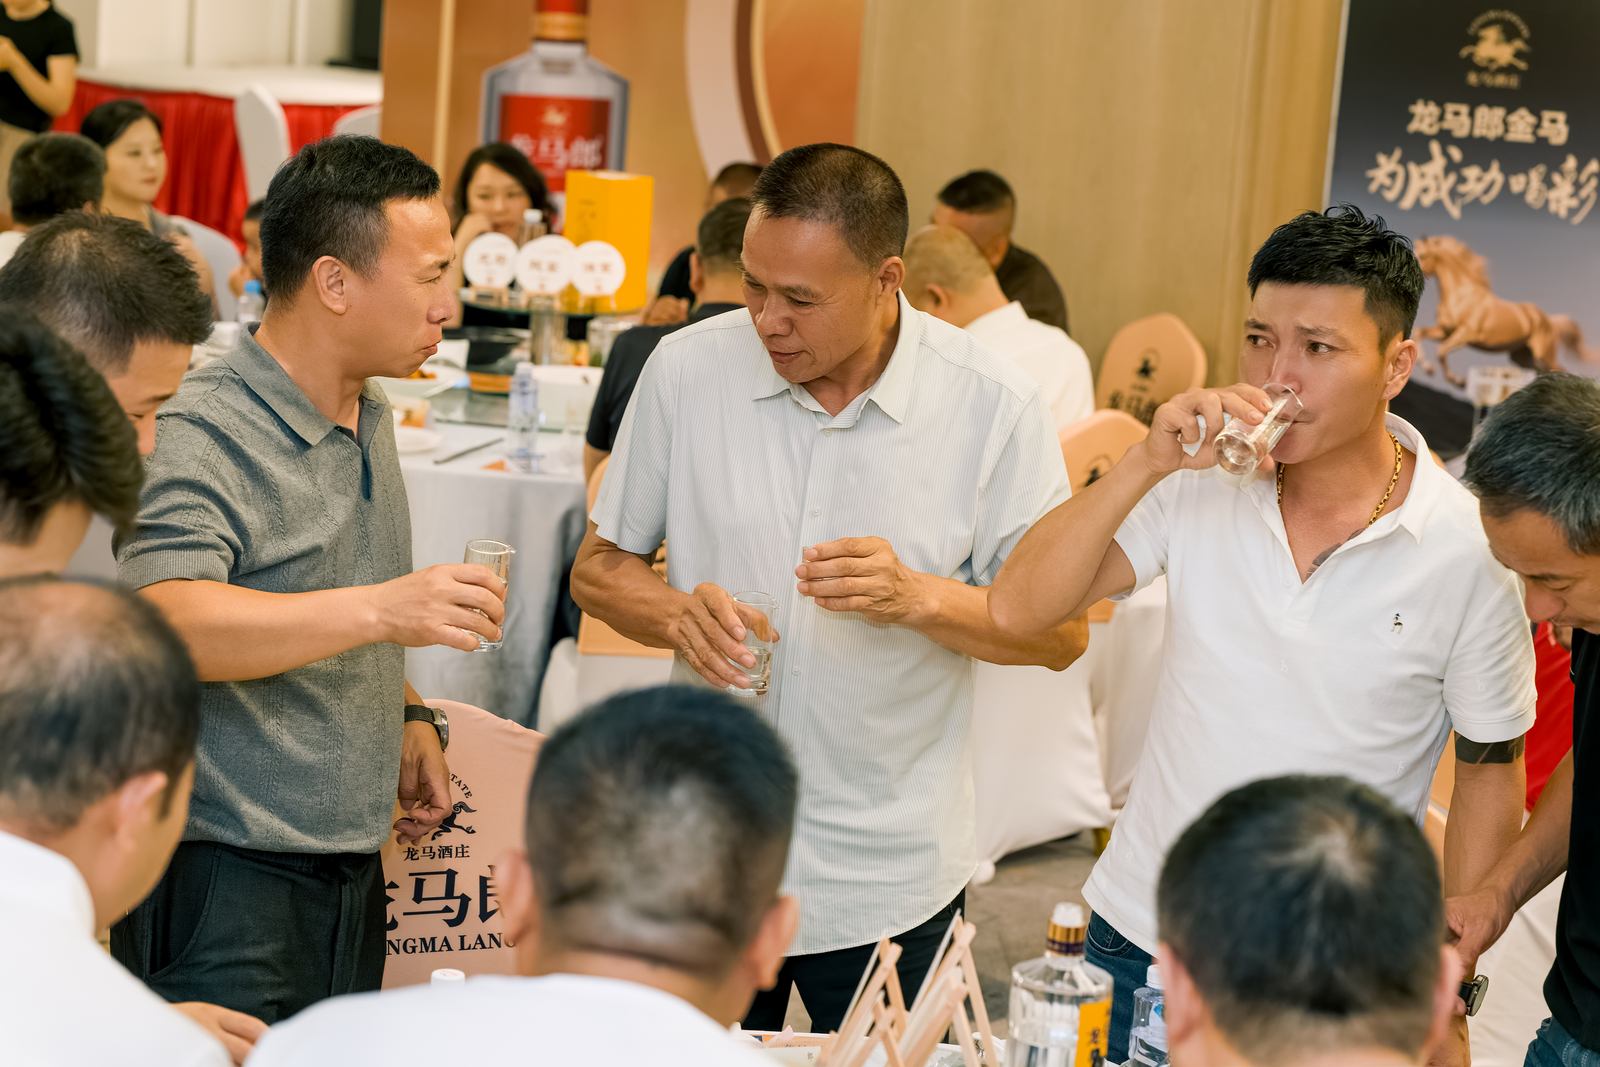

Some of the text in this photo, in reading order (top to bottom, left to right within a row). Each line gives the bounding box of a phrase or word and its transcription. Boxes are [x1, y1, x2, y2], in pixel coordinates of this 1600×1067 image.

[1407, 99, 1570, 146] 龙马郎金马
[1365, 139, 1600, 225] 为成功喝彩
[449, 773, 473, 799] TATE
[403, 844, 471, 861] 龙马酒庄
[386, 935, 454, 956] NGMA
